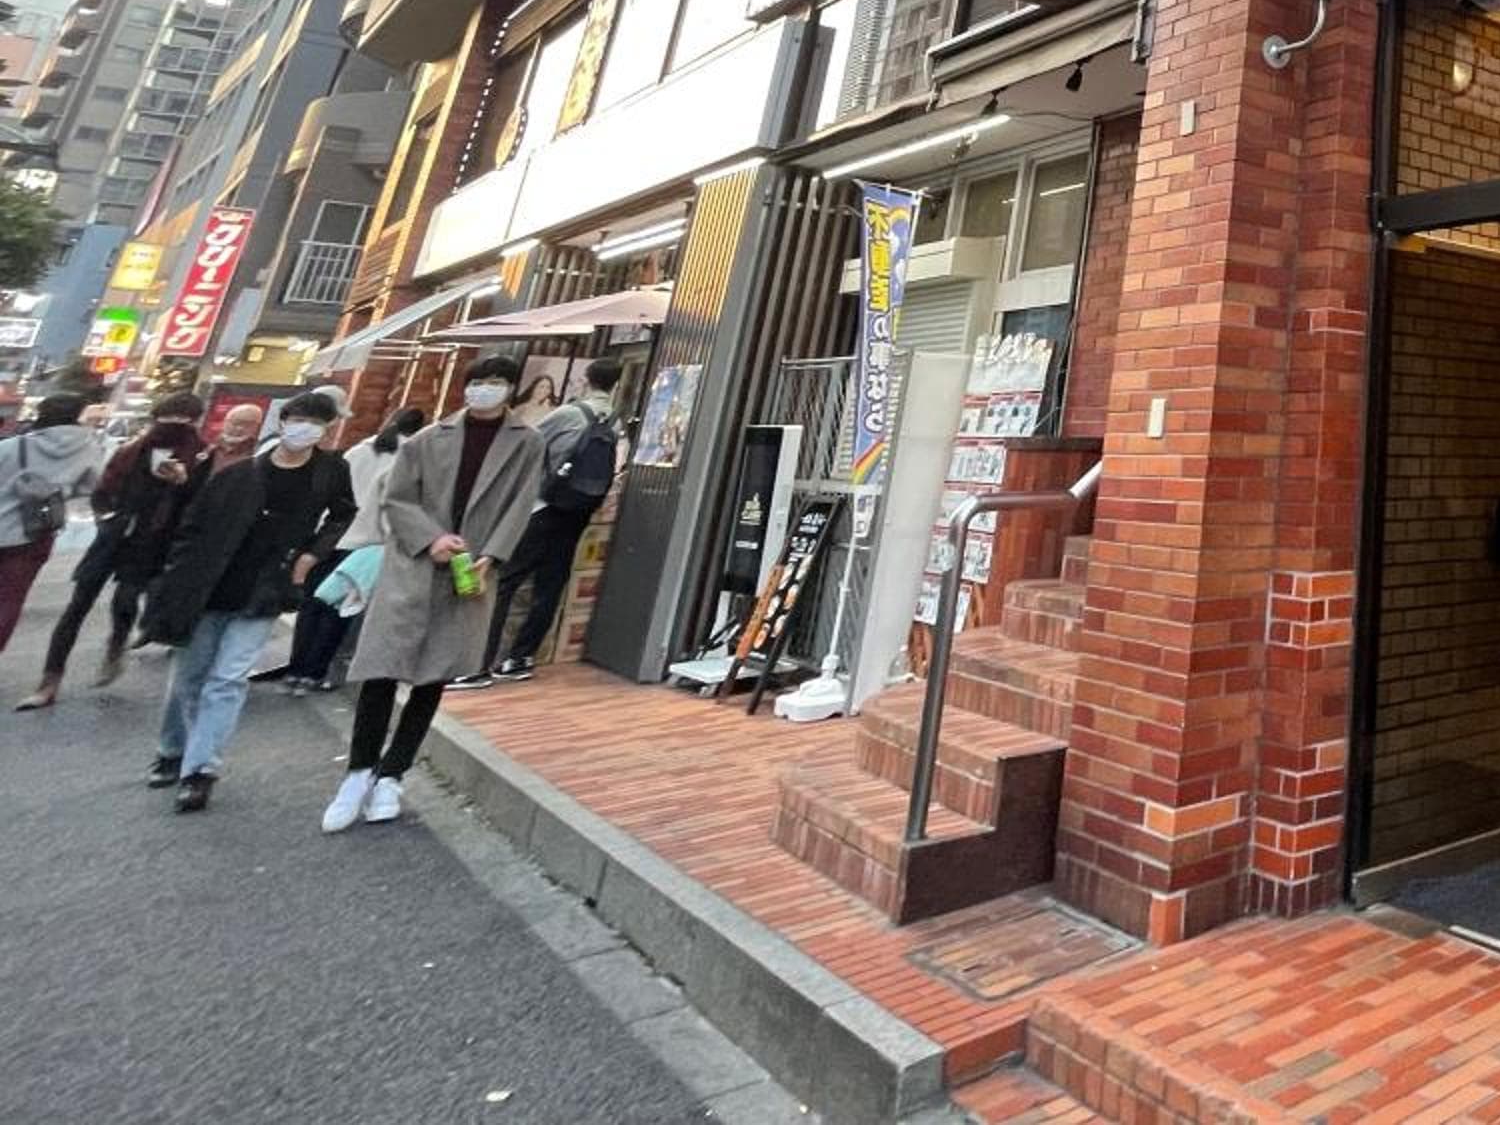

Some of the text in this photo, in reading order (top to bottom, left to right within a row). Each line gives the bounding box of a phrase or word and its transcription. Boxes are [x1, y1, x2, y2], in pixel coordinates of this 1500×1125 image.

[164, 224, 243, 350] クリーニング
